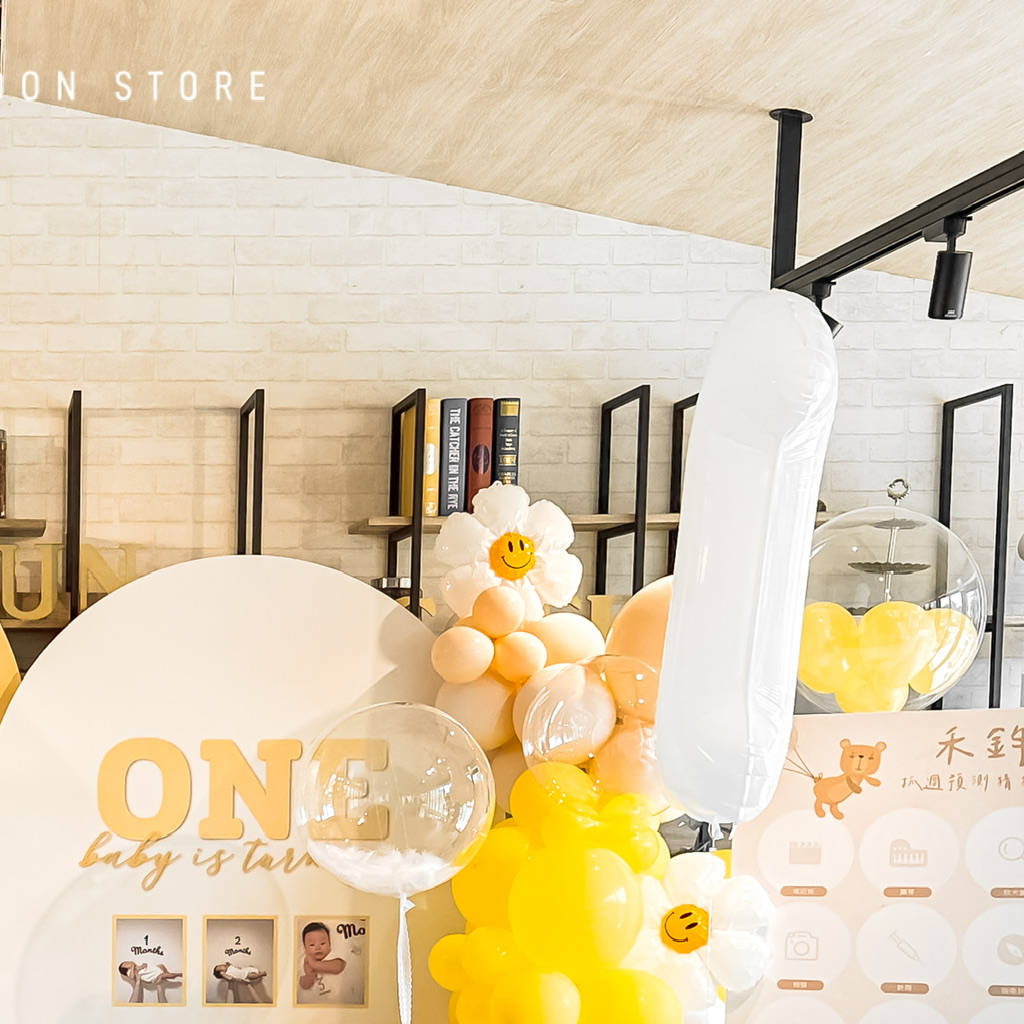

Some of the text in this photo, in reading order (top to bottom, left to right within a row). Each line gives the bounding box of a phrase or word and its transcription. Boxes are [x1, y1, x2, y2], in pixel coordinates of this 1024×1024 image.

[449, 408, 461, 424] THE
[448, 426, 461, 463] CATCHER
[448, 476, 459, 491] THE
[447, 492, 459, 510] RYE
[96, 736, 390, 841] ONE
[78, 830, 182, 891] baby
[192, 847, 235, 876] is
[143, 934, 149, 946] 1
[234, 936, 241, 946] 2
[130, 945, 164, 956] Months
[224, 947, 251, 956] Months
